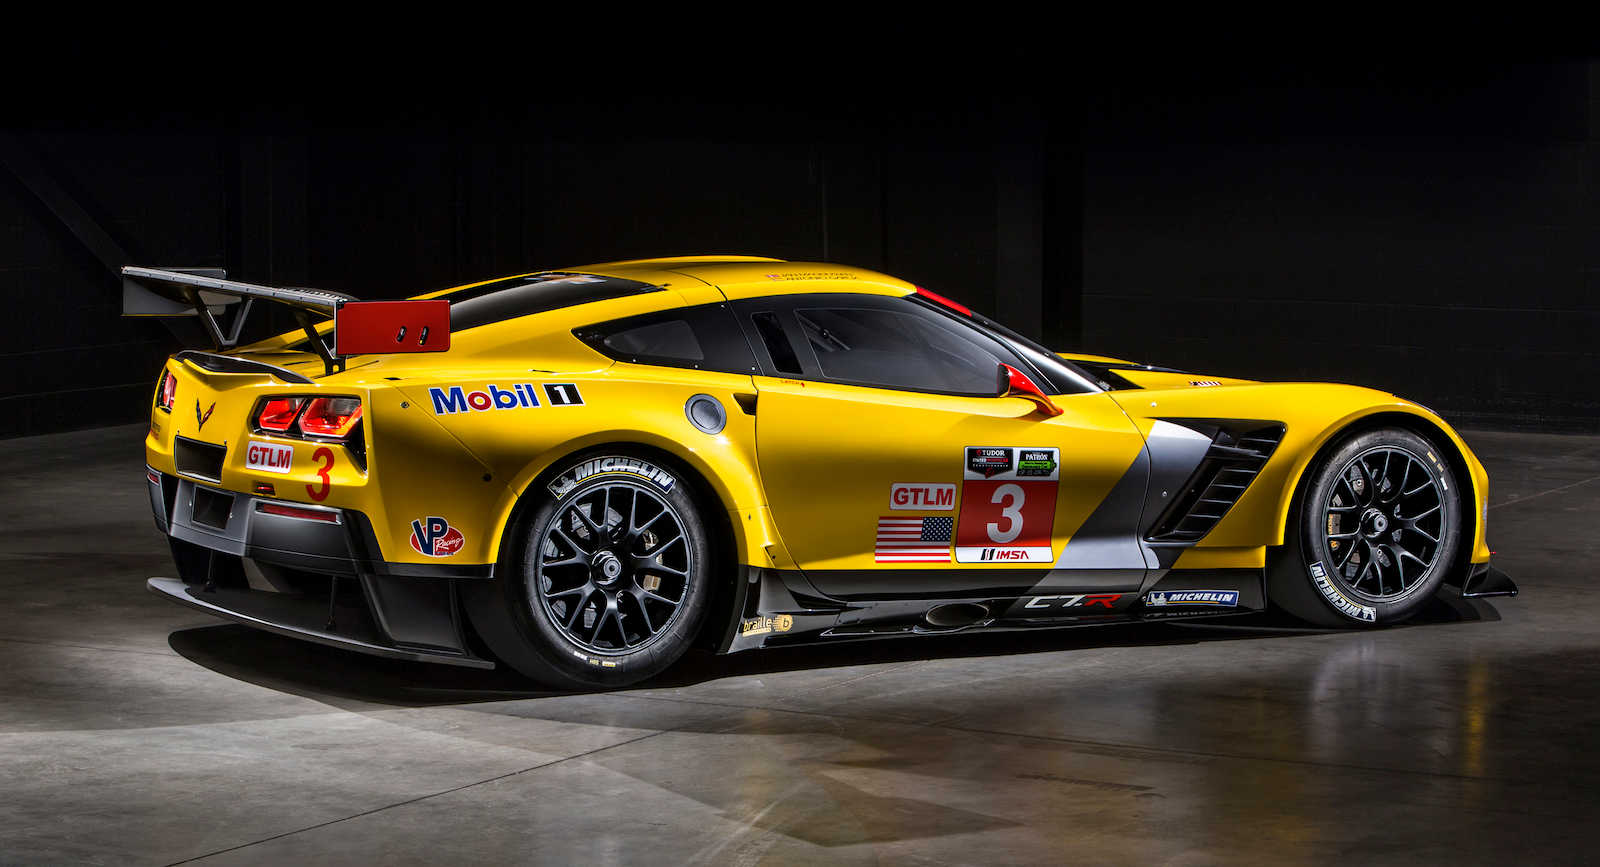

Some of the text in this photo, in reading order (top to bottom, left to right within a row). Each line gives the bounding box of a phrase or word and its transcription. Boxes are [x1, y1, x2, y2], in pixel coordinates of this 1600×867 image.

[429, 384, 572, 414] Mobil 1
[248, 445, 291, 469] GTLM
[306, 447, 335, 502] 3
[575, 458, 674, 488] MICHELIN
[893, 487, 953, 506] GTLM
[986, 483, 1026, 544] 3
[412, 517, 449, 556] VP
[996, 550, 1030, 560] IMSA
[1168, 592, 1235, 602] MICHELIN
[1311, 565, 1361, 617] MICHELIN
[744, 616, 772, 632] braille
